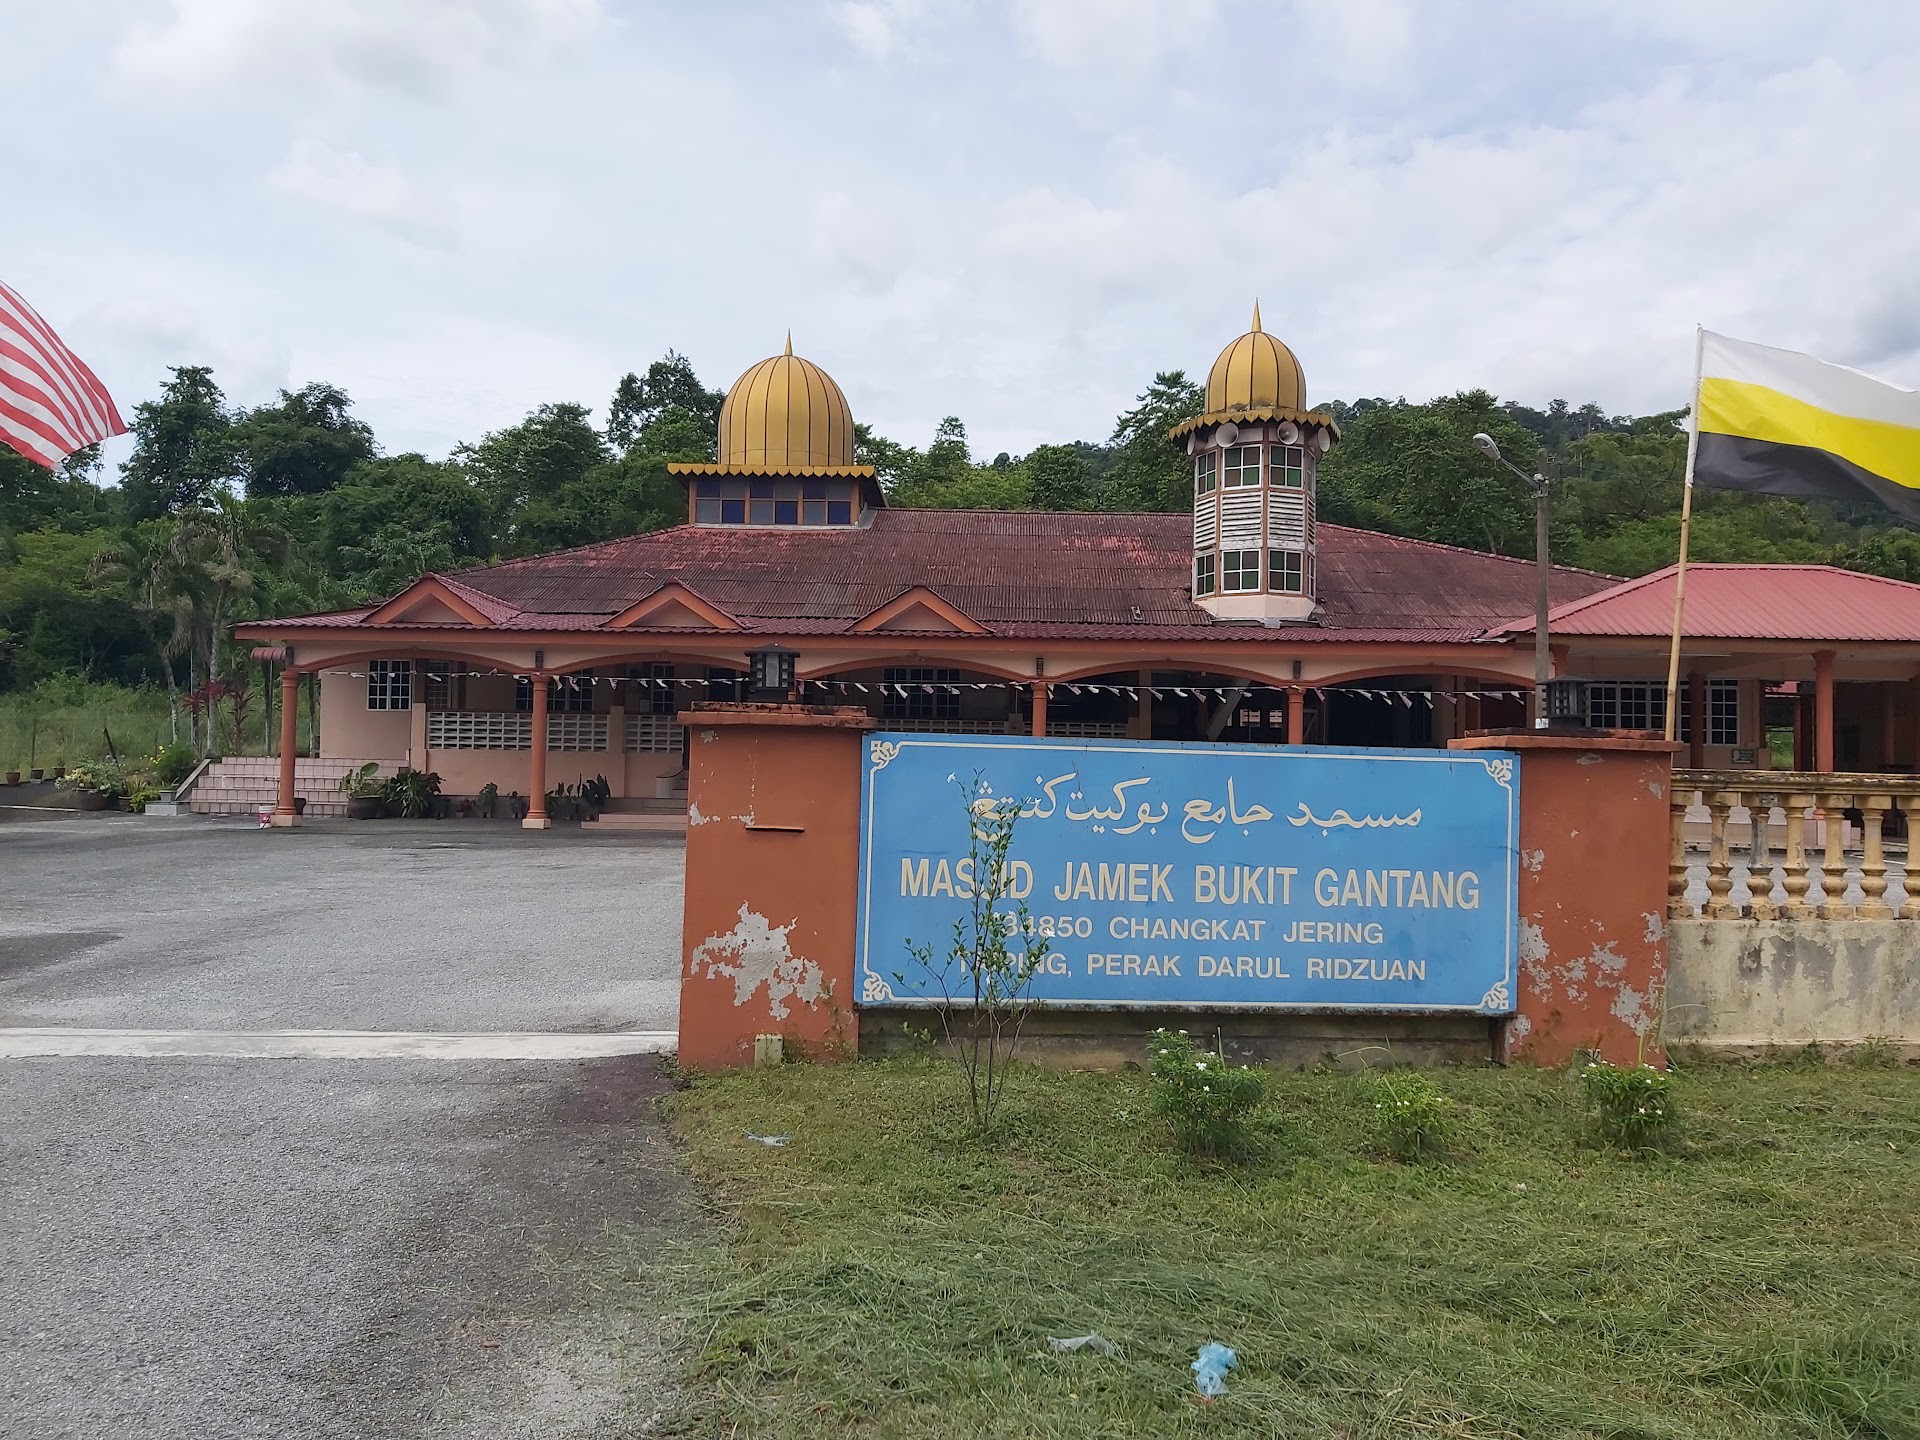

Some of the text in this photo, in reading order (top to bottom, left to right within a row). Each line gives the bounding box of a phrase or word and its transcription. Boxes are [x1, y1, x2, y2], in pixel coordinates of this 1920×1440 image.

[1181, 775, 1274, 844] جامع
[1286, 801, 1422, 837] مسجد
[1054, 861, 1174, 902] JAMEK
[1195, 864, 1298, 905] BUKIT
[1314, 867, 1479, 910] GANTANG
[1002, 913, 1383, 944] 34850 CHANGKAT JERING
[1087, 953, 1181, 977] PERAK
[1198, 955, 1289, 979] DARUL
[1307, 958, 1426, 981] RIDZUAN
